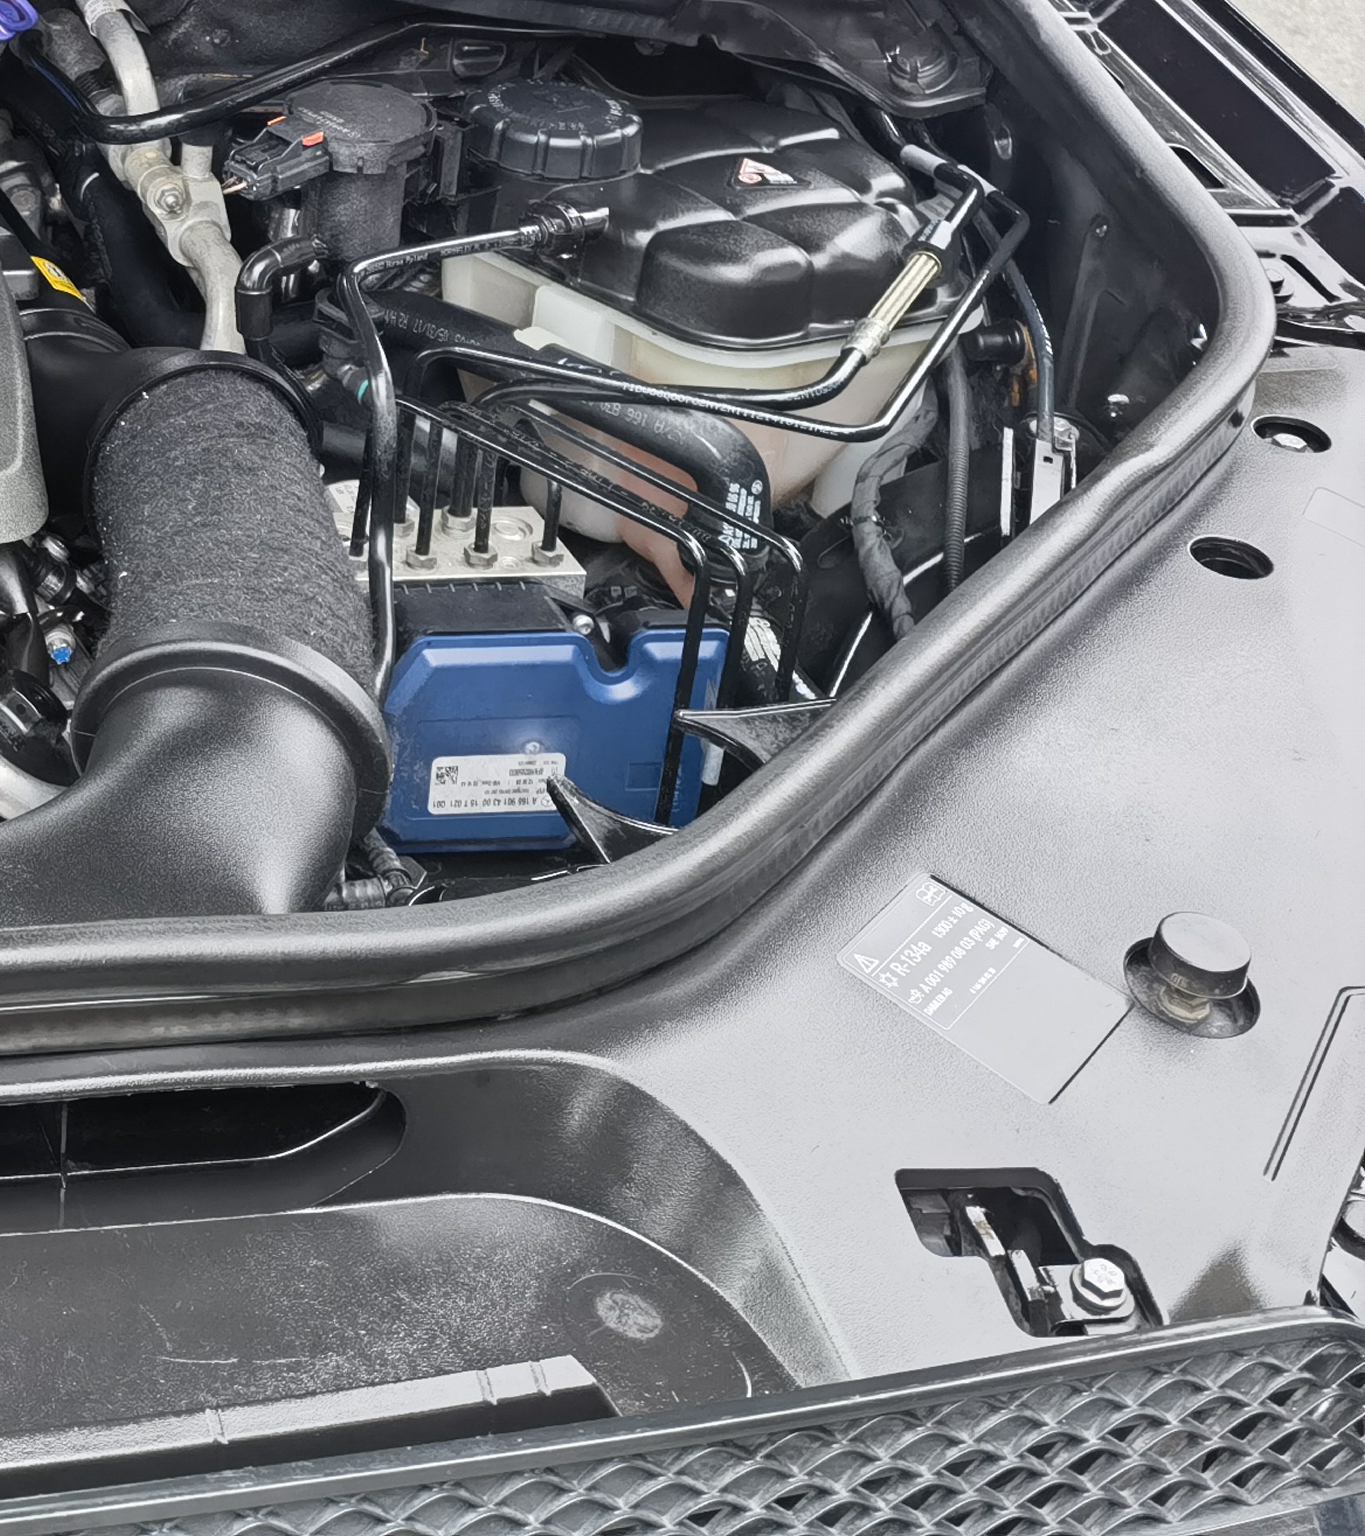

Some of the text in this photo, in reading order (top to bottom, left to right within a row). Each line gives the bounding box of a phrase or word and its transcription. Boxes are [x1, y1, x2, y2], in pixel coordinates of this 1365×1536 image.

[889, 941, 933, 976] R-134a
[924, 969, 945, 987] 001
[937, 955, 957, 973] 989
[968, 918, 996, 942] (PAG)
